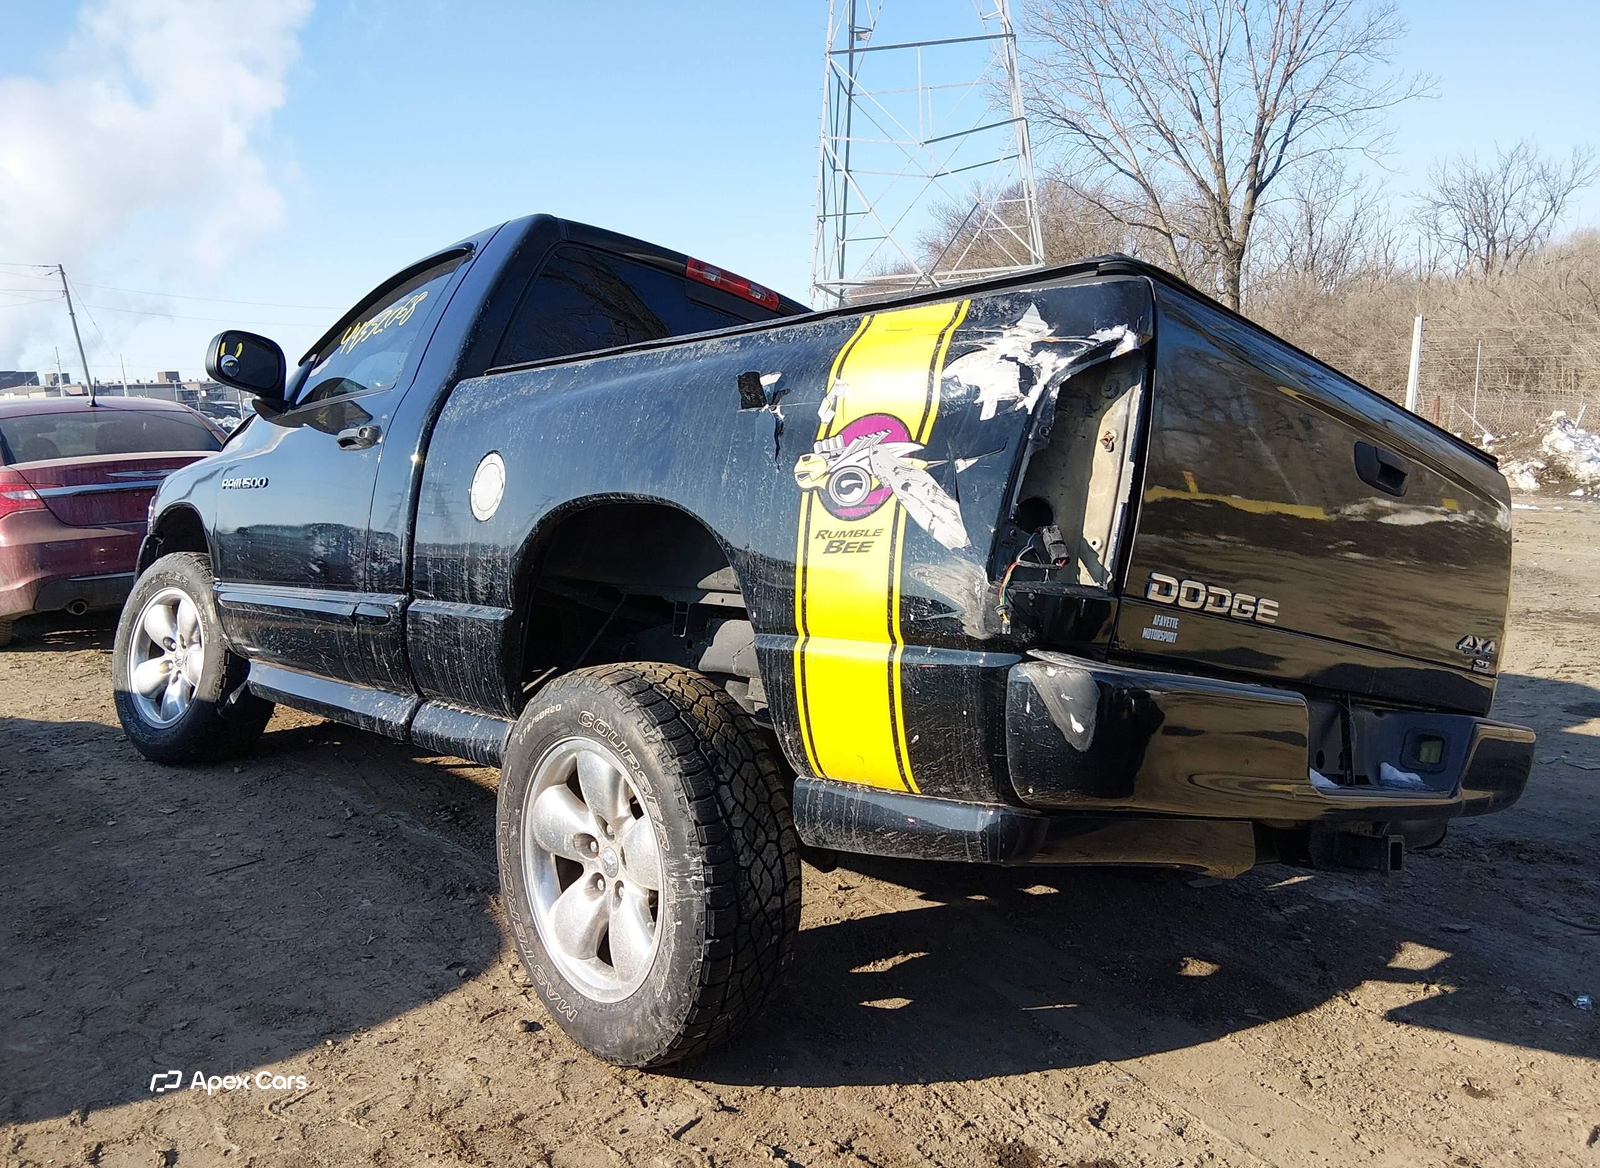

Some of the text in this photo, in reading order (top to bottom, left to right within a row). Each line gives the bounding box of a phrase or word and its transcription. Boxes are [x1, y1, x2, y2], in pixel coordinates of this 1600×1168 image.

[814, 528, 885, 540] RUMBLE
[822, 539, 875, 555] BEE
[1145, 572, 1280, 624] DODGE
[578, 710, 670, 852] COURSER
